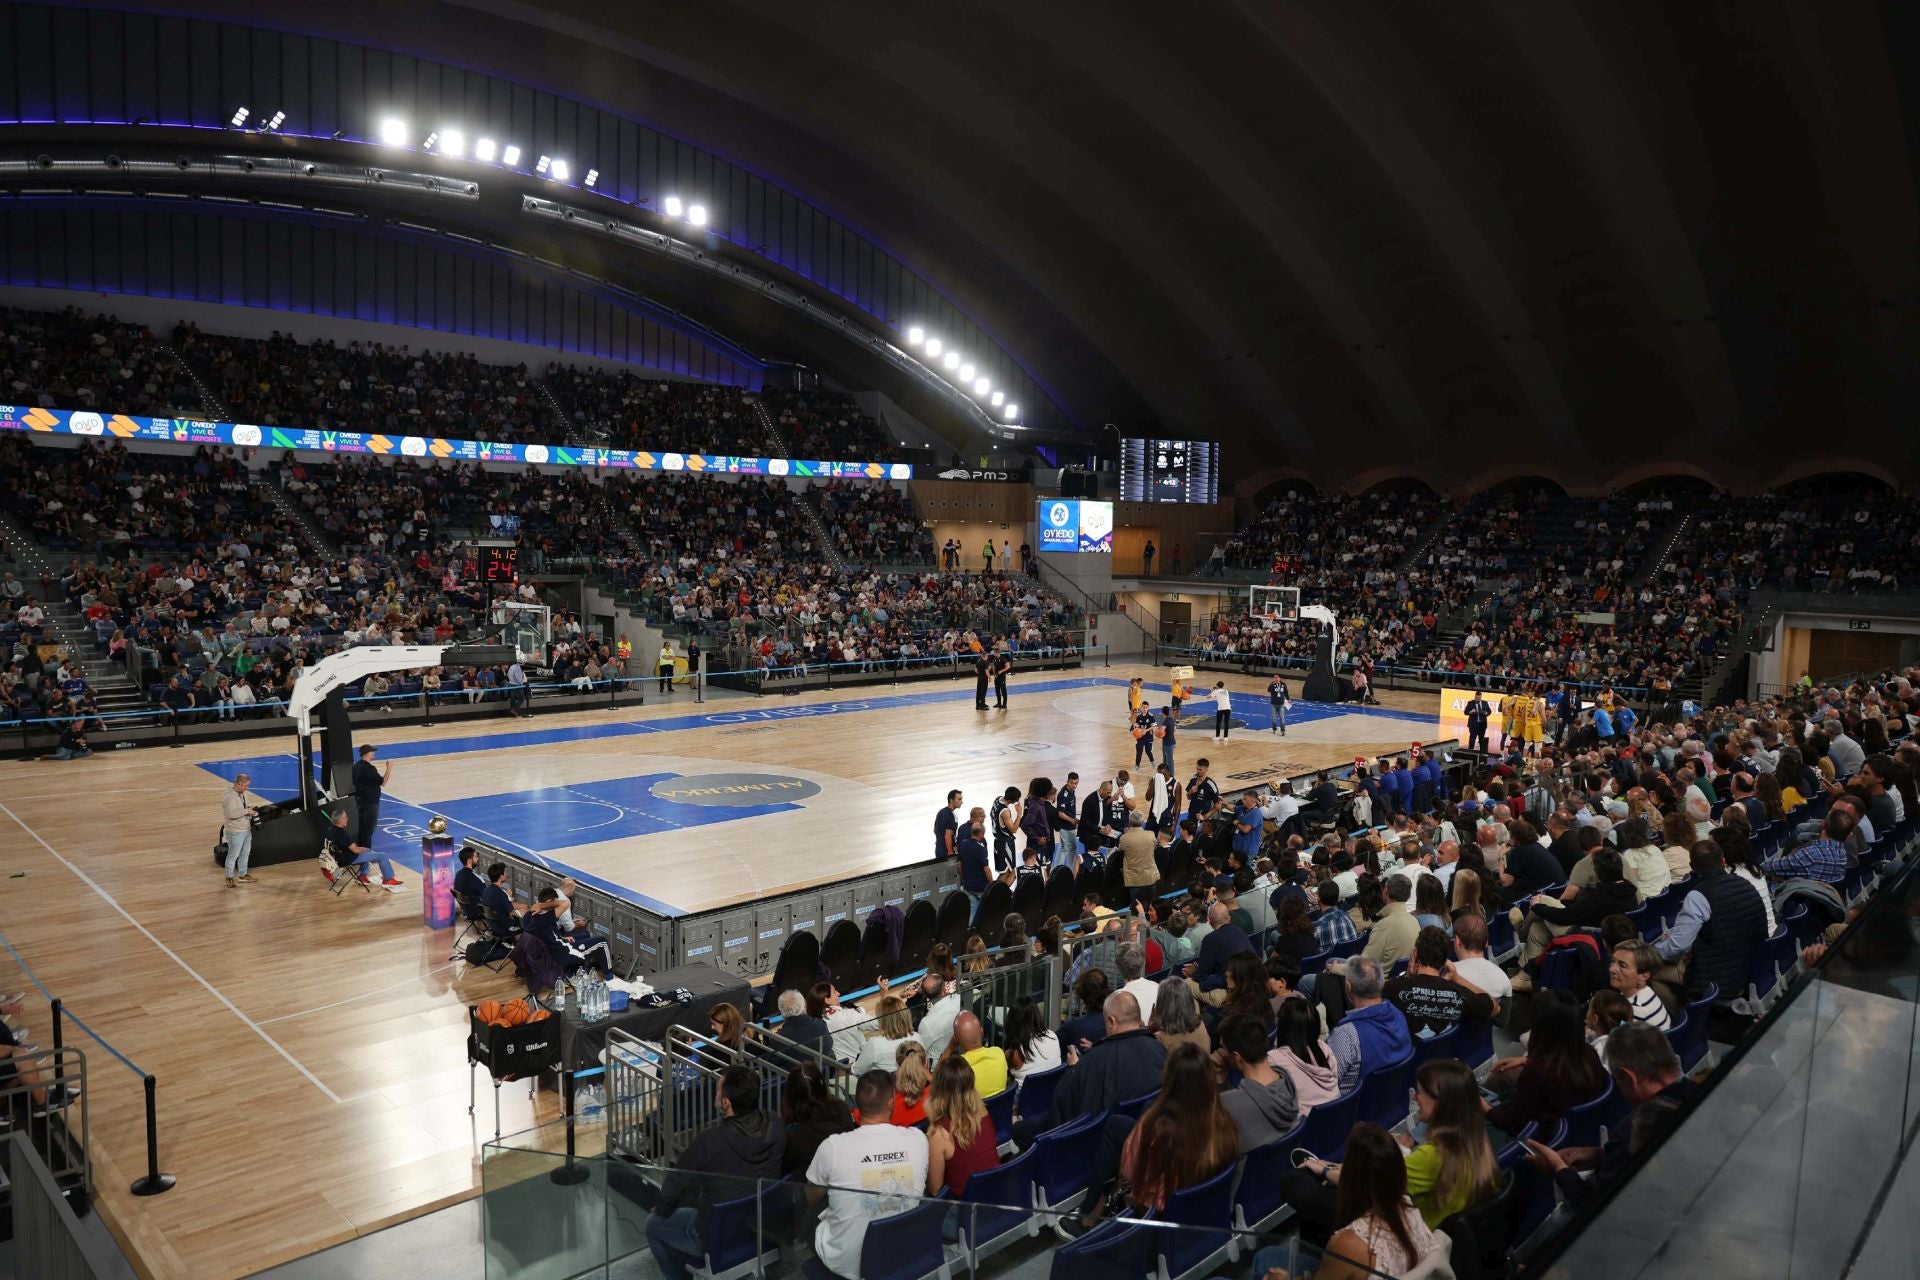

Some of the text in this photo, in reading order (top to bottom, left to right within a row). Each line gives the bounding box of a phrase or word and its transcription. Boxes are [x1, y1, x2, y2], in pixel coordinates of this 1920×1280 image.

[1044, 529, 1075, 538] OVIEDO
[492, 549, 517, 560] 4:12
[488, 562, 512, 577] 24
[1275, 562, 1287, 572] 24
[706, 702, 870, 722] OVIEDO
[1412, 746, 1420, 756] 5
[660, 780, 802, 798] ALIMERKA
[526, 1042, 548, 1052] Wilson
[873, 1152, 904, 1162] TERREX
